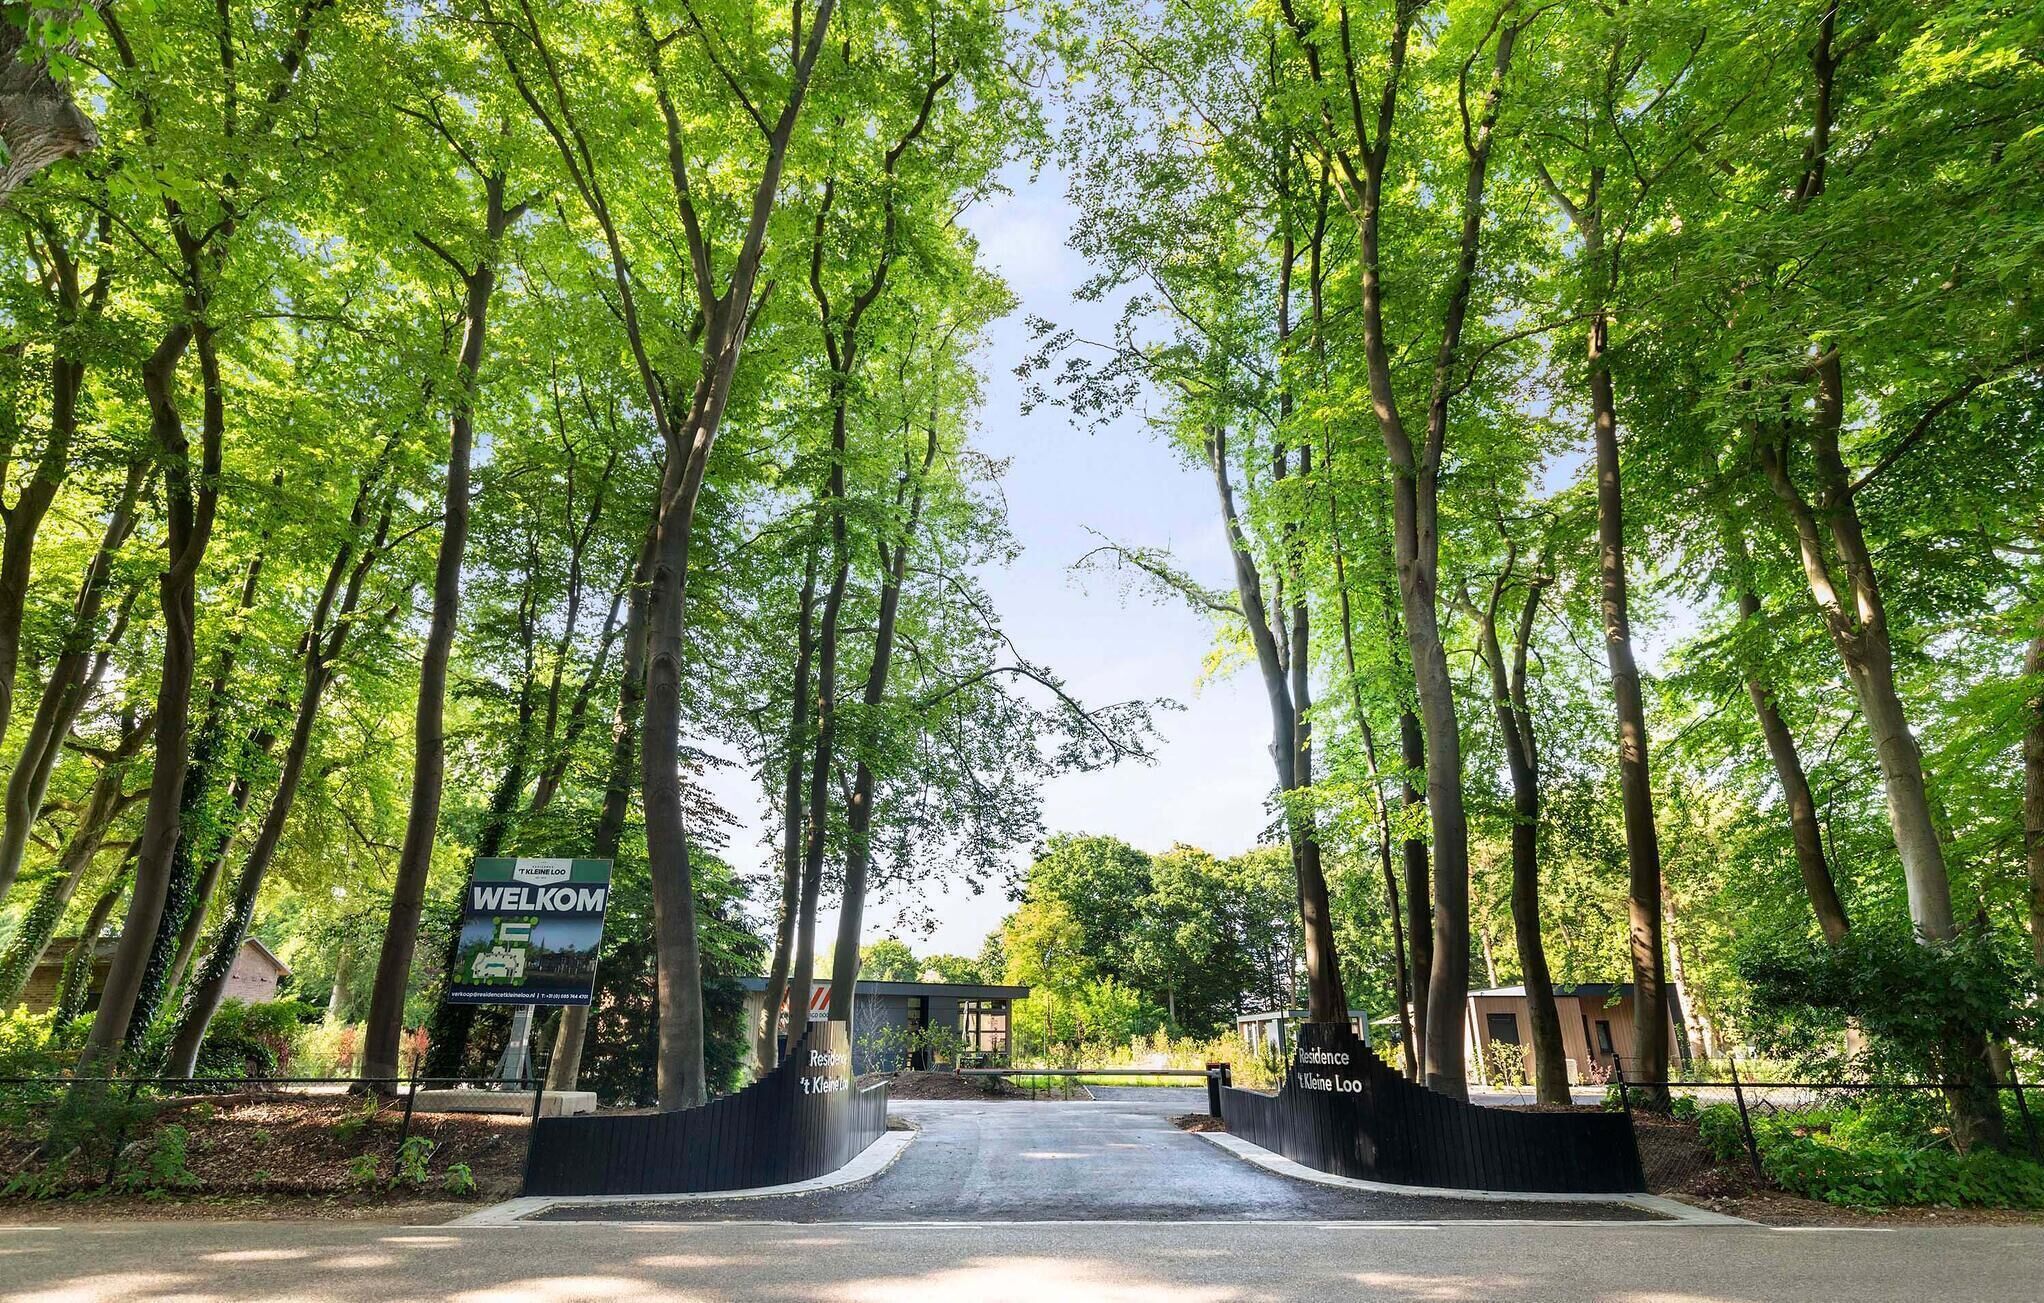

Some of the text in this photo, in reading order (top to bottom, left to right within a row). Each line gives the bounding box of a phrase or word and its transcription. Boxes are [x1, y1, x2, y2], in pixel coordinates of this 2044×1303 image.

[473, 887, 606, 912] WELKOM
[1298, 1046, 1350, 1065] Residence
[799, 1076, 810, 1095] 't
[812, 1075, 839, 1094] Kleine
[1297, 1072, 1363, 1093] 't Kleine Loo
